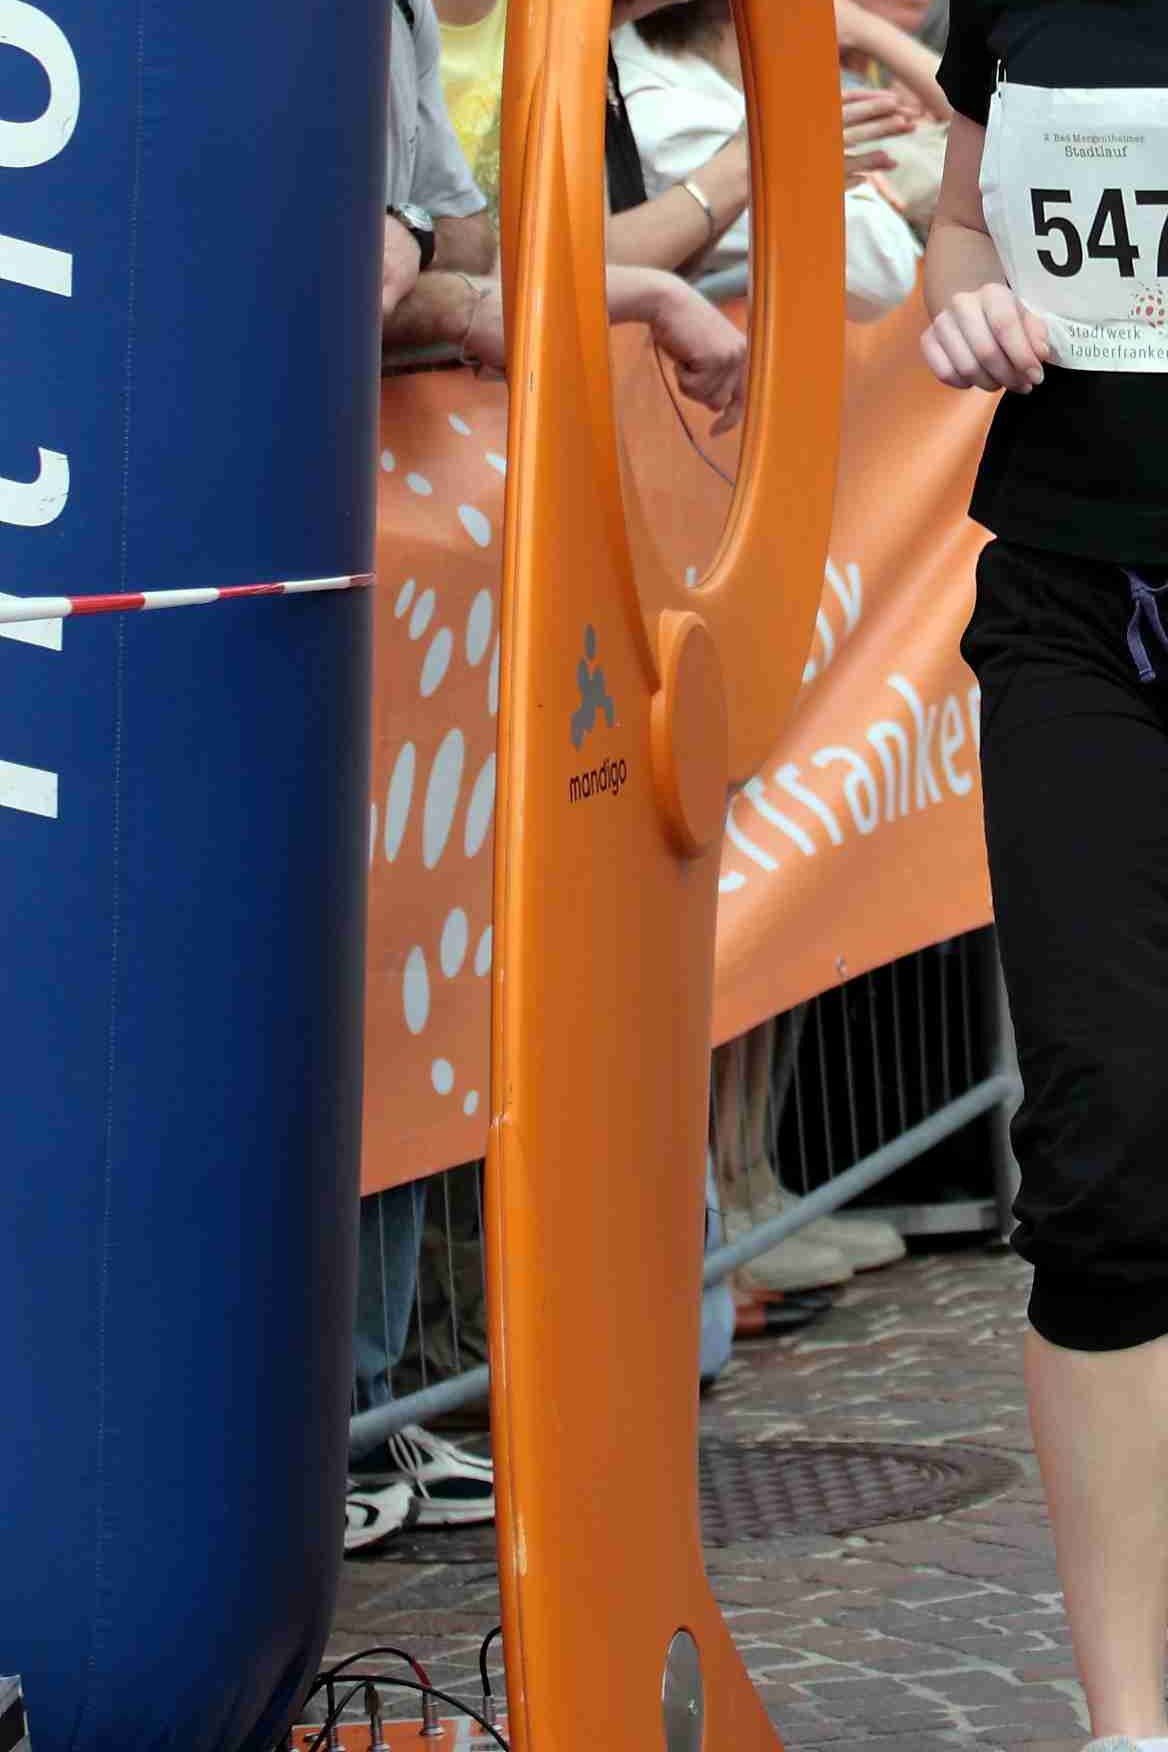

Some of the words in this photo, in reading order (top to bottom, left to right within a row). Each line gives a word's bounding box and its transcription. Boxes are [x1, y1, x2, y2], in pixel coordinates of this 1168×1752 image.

[1064, 144, 1128, 158] Stadtlauf
[1069, 322, 1142, 340] Stadtwerk
[569, 757, 627, 805] mandigo
